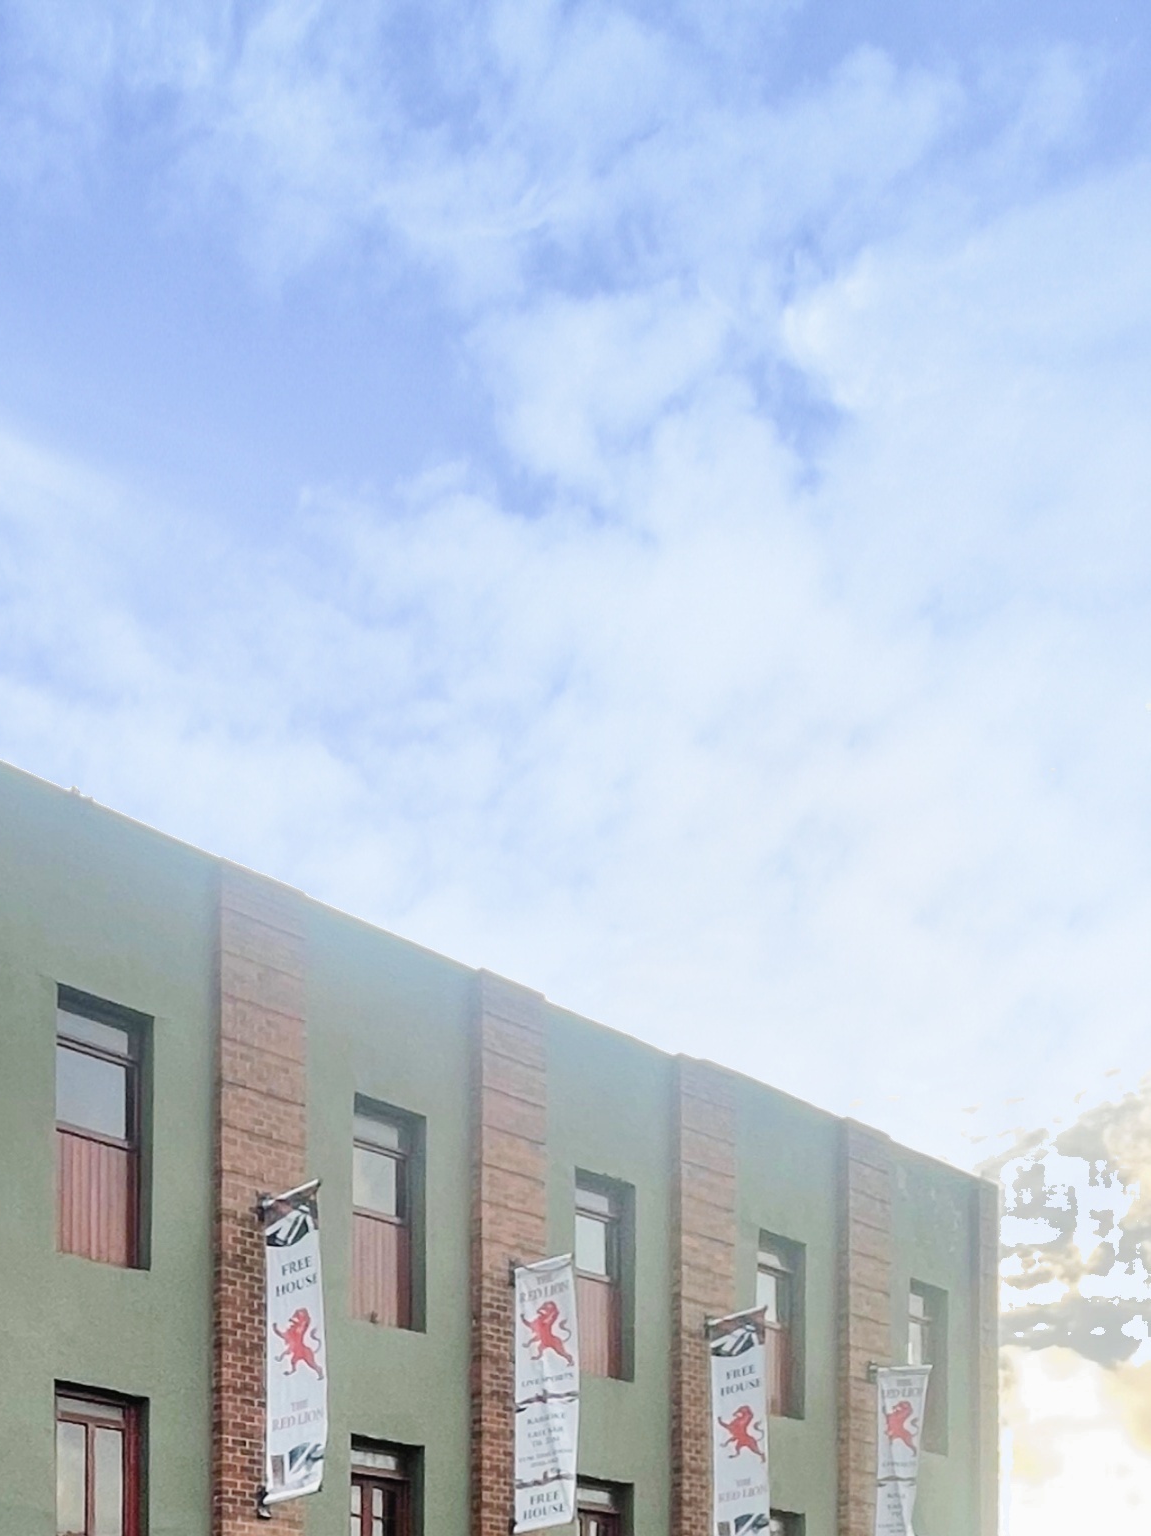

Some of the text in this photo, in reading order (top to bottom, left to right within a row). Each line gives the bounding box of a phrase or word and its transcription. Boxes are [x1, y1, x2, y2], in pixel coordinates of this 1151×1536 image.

[281, 1256, 312, 1276] FREE
[275, 1273, 318, 1297] HOUSE
[726, 1364, 756, 1381] FREE
[720, 1378, 761, 1397] HOUSE
[272, 1406, 324, 1432] RED LION
[529, 1490, 560, 1505] FREE
[523, 1503, 565, 1520] HOUSE
